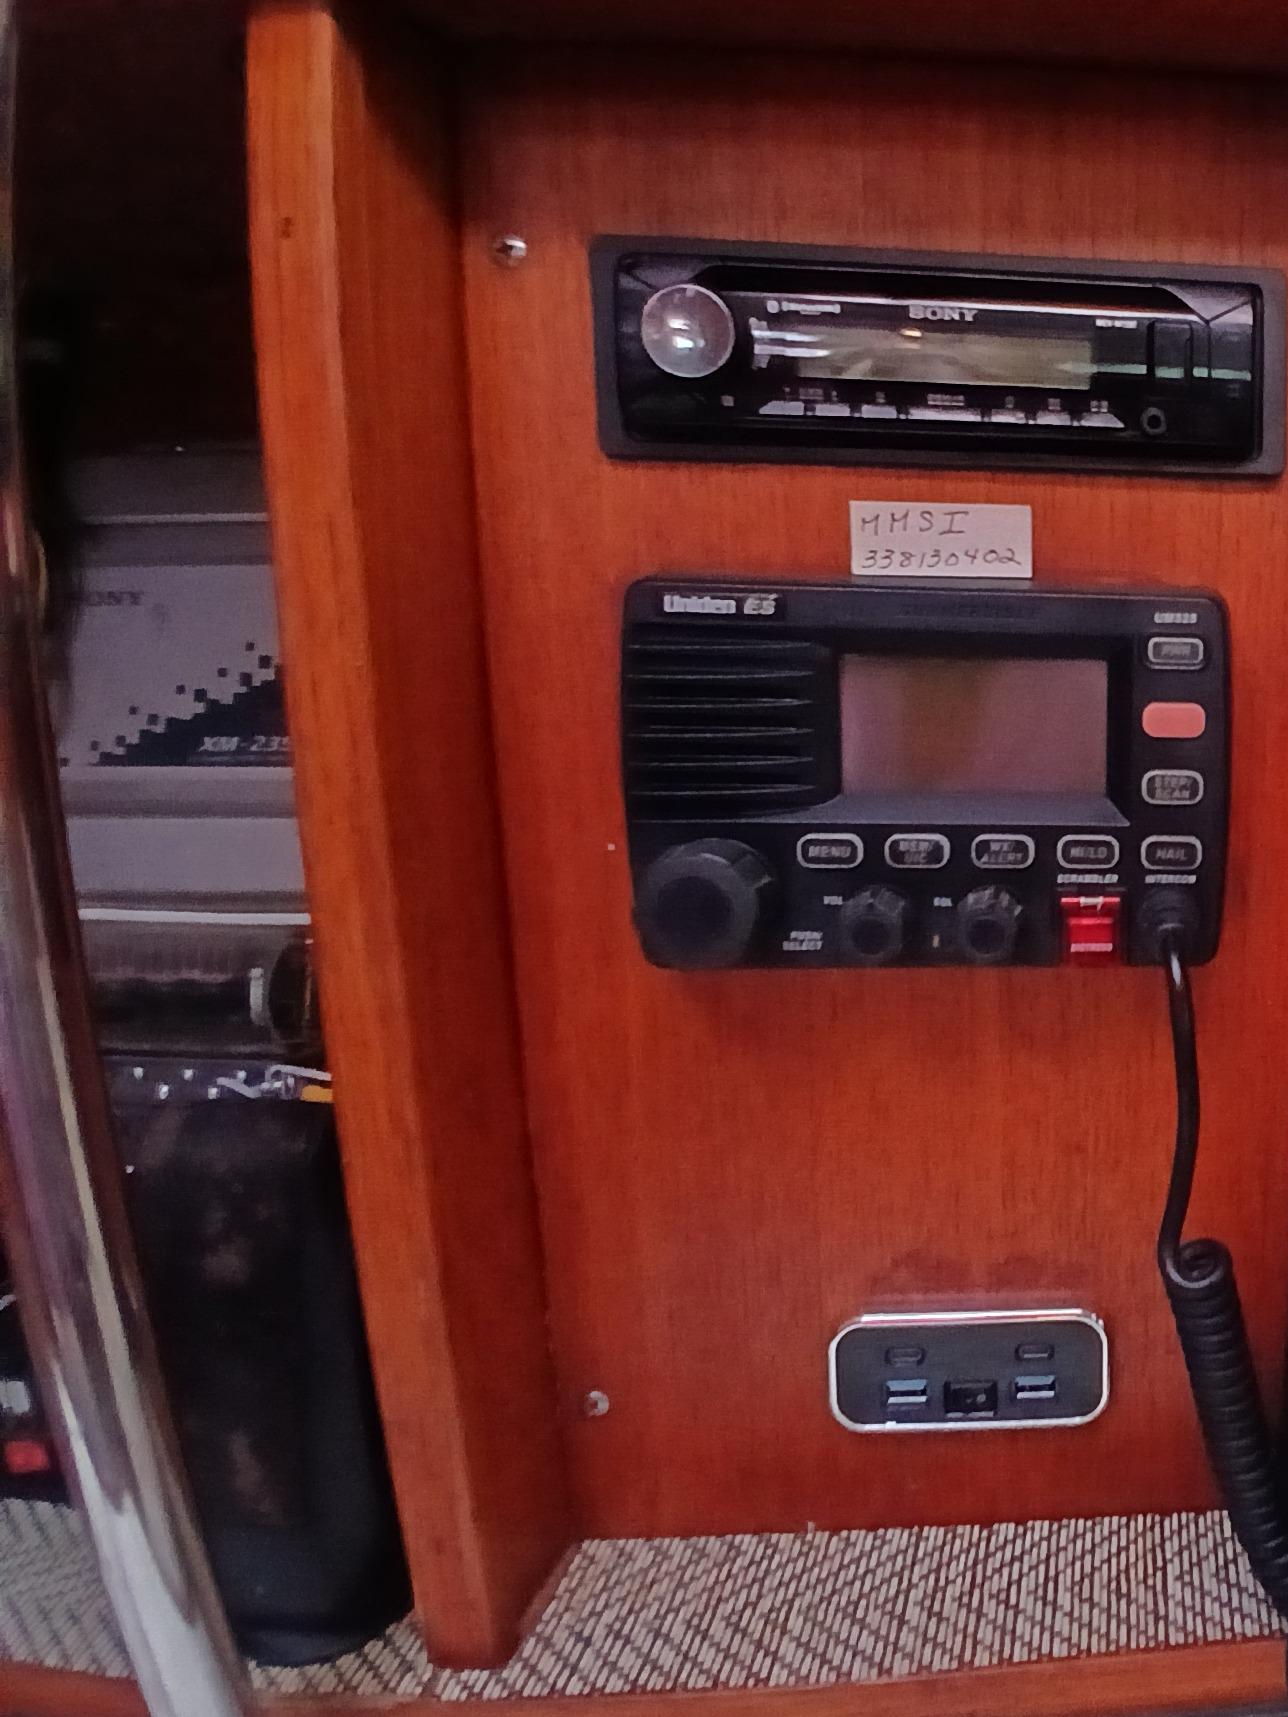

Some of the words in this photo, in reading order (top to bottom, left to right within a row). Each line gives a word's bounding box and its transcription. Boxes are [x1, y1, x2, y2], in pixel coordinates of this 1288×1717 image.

[909, 304, 979, 321] SONY
[861, 510, 969, 536] MMSI
[862, 548, 1021, 569] 338130402
[664, 595, 736, 613] Uniden
[808, 845, 850, 858] MENU
